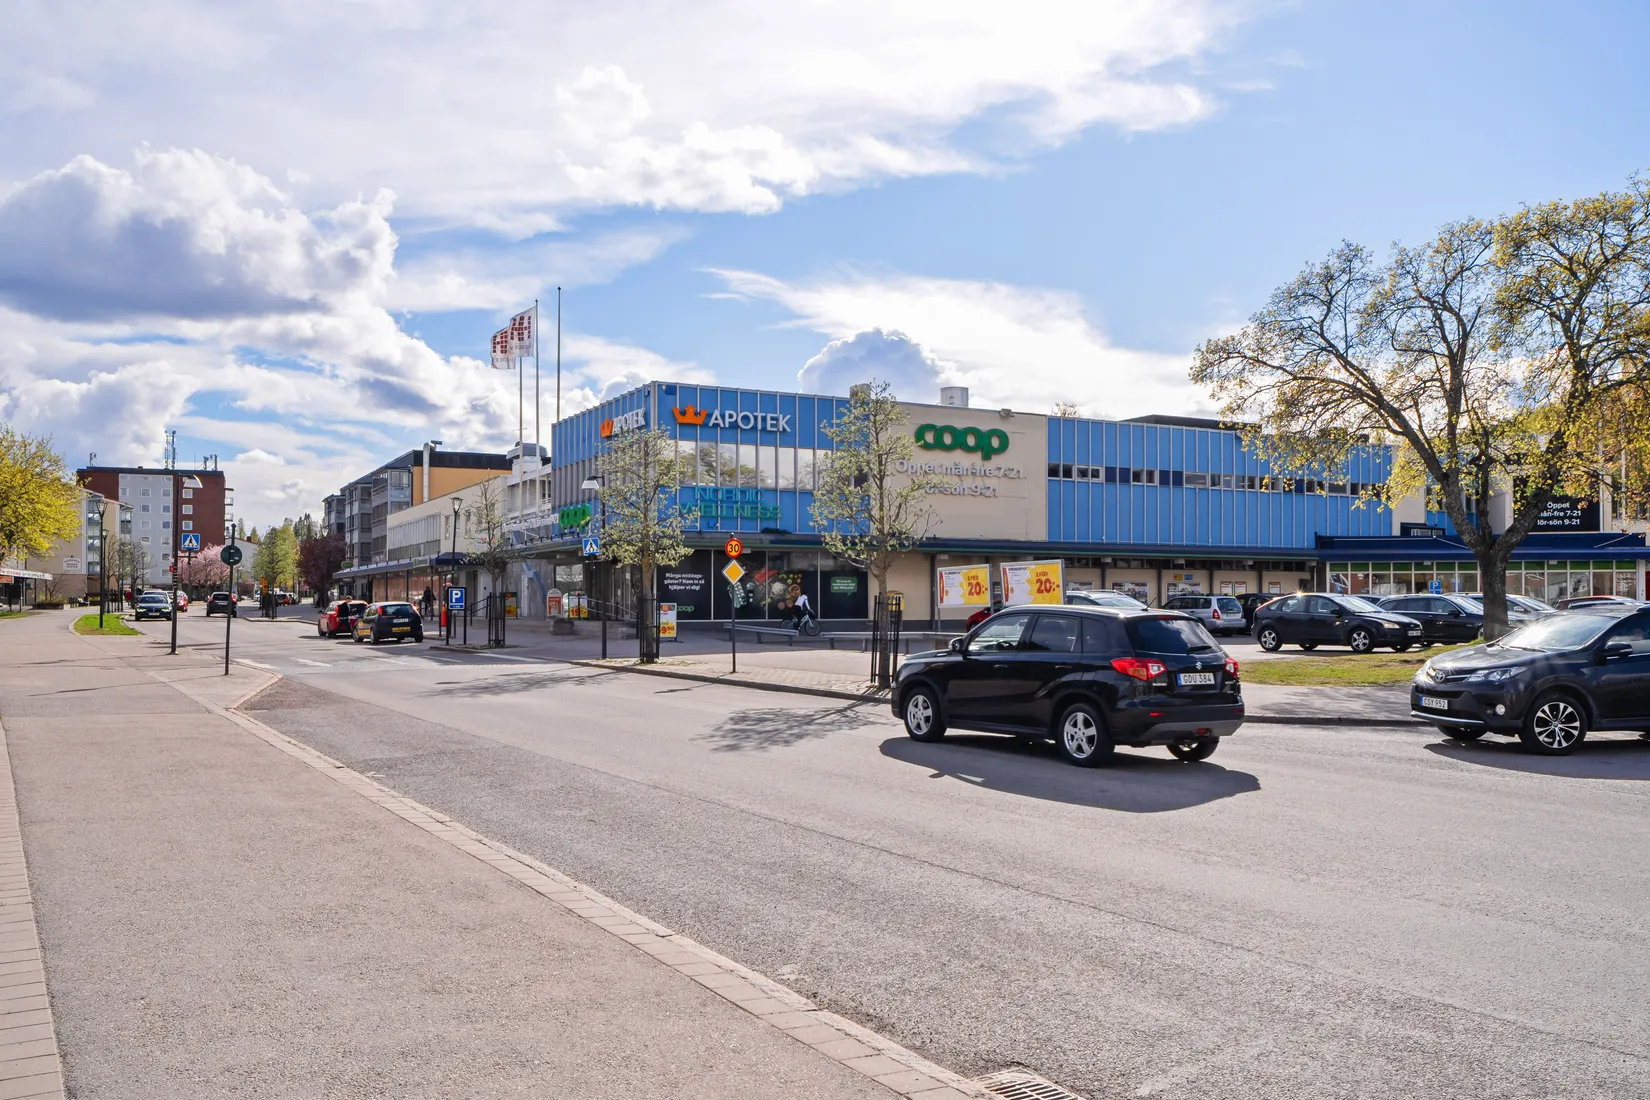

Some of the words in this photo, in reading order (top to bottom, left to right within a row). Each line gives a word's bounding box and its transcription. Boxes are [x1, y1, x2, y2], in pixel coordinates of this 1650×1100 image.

[612, 408, 646, 435] APOTEK
[708, 408, 792, 432] APOTEK
[914, 423, 1010, 461] coop
[694, 486, 765, 502] NORDIC
[680, 502, 782, 519] WELLNESS
[1546, 501, 1570, 509] Öppet
[728, 543, 740, 553] 30
[1036, 578, 1060, 594] 20:-
[452, 590, 461, 603] P
[1183, 674, 1197, 684] GDU
[1199, 674, 1212, 683] 384
[1424, 697, 1434, 706] CSY
[1434, 699, 1446, 708] 952
